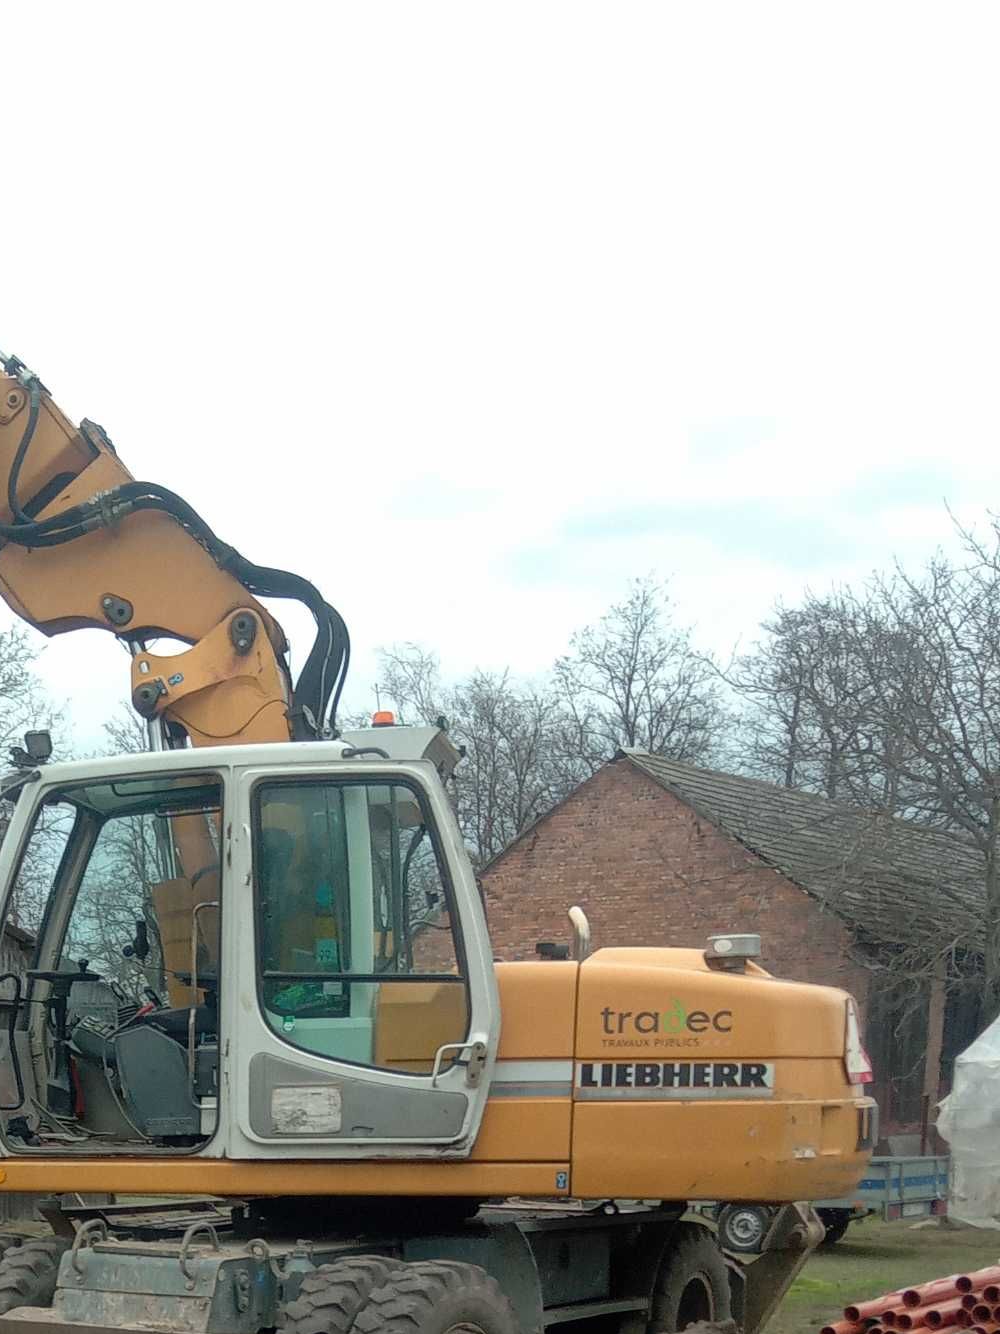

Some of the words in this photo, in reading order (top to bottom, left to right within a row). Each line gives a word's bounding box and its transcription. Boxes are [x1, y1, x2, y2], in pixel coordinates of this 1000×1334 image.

[601, 1039, 650, 1048] TRAVAUX
[654, 1038, 700, 1048] PUBLICS
[580, 1063, 769, 1087] LIEBHERR
